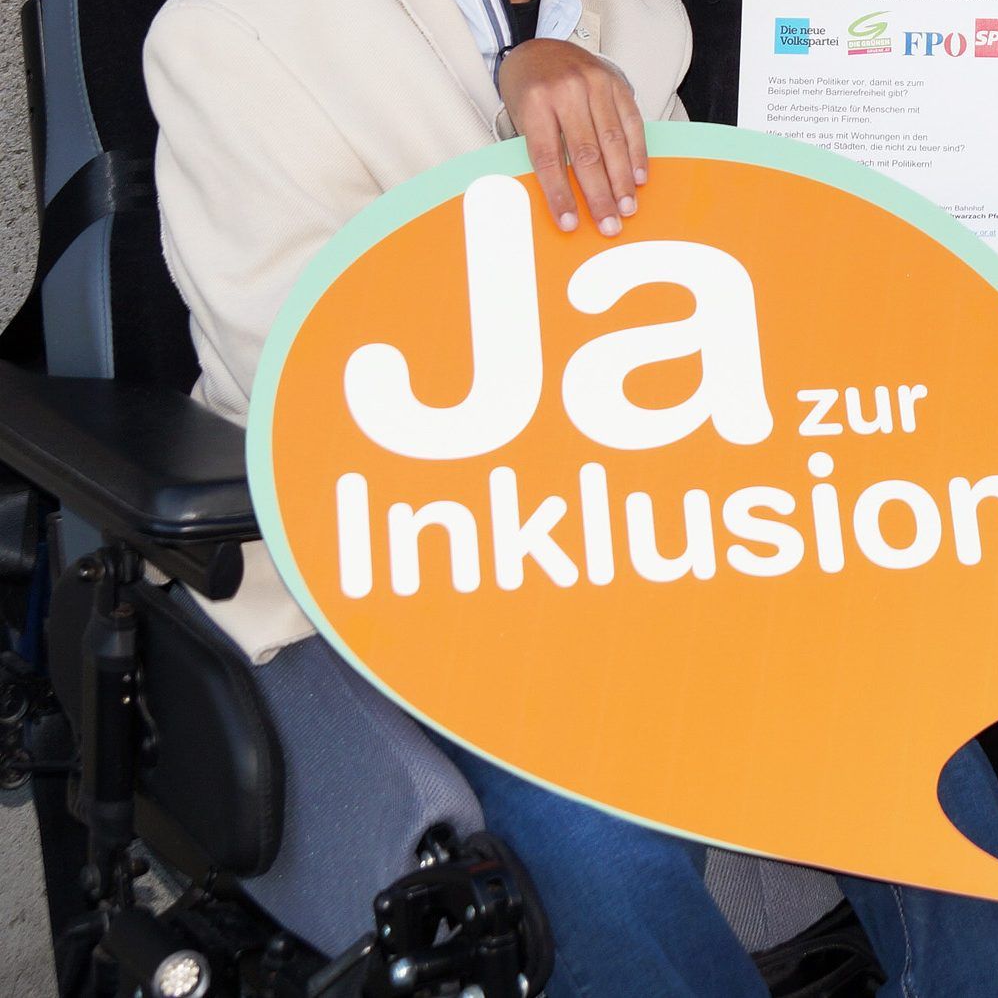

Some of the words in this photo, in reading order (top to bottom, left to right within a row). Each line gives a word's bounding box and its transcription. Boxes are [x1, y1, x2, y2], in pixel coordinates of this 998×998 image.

[780, 25, 798, 35] Die
[799, 26, 826, 35] neue
[780, 36, 839, 48] Volkspartei
[768, 76, 787, 85] Was
[788, 77, 815, 86] haben
[816, 77, 849, 86] Politiker
[869, 78, 892, 87] damit
[767, 86, 800, 97] Beispiel
[802, 87, 824, 96] mehr
[825, 87, 886, 97] Barrierefreiheit
[888, 89, 909, 98] gibt?
[767, 104, 788, 112] Oder
[849, 104, 861, 113] für
[862, 105, 905, 114] Menschen
[907, 106, 921, 114] mit
[766, 114, 829, 124] Behinderungen
[831, 115, 839, 123] in
[841, 115, 872, 124] Firmen.
[784, 131, 804, 139] sieht
[850, 131, 901, 142] Wohnungen
[903, 133, 911, 141] in
[912, 133, 928, 142] den
[870, 143, 883, 151] die
[885, 143, 905, 152] nicht
[906, 144, 917, 152] zu
[919, 144, 941, 152] teuer
[943, 144, 966, 153] sind?
[877, 160, 890, 168] mit
[892, 160, 933, 169] Politikern!
[343, 173, 774, 460] Ja
[797, 383, 929, 437] zur
